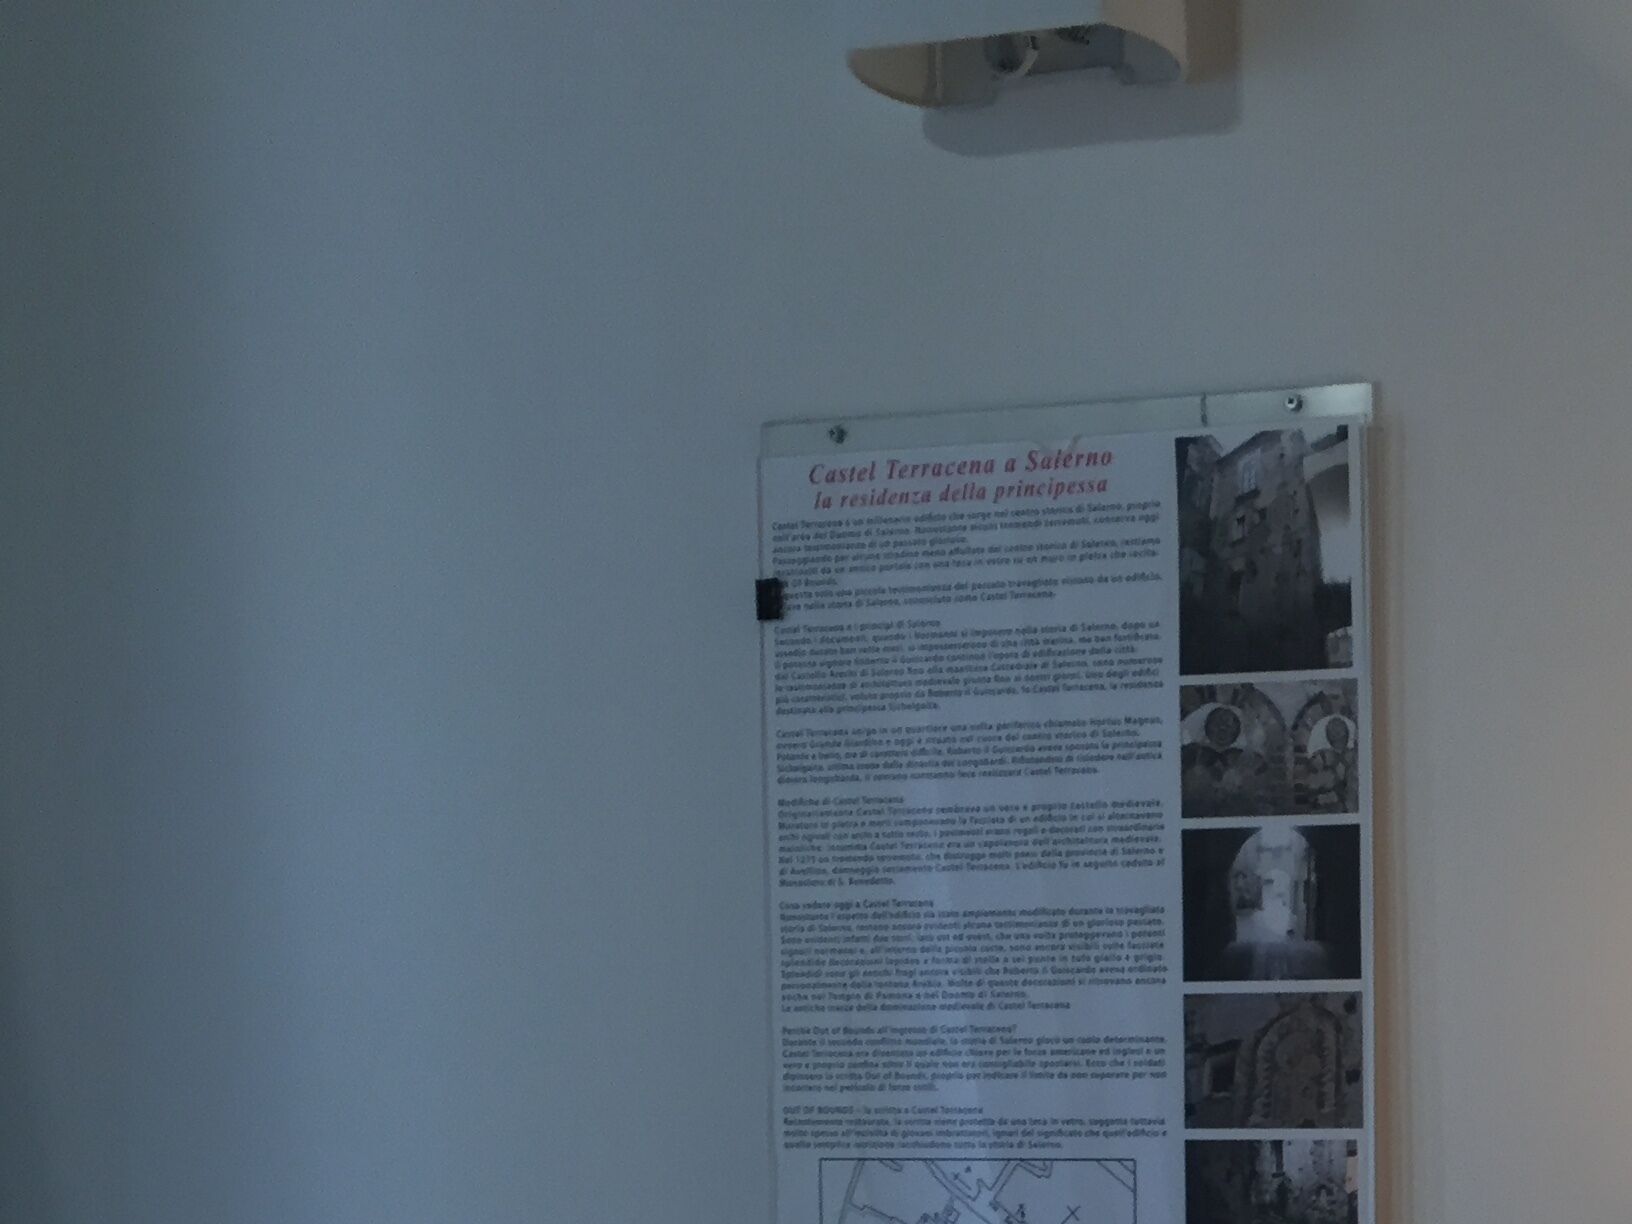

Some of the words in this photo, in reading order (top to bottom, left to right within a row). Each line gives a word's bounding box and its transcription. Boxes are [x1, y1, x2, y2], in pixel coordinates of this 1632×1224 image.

[809, 460, 876, 485] Castel
[886, 455, 995, 480] Terracena
[1003, 456, 1017, 473] a
[1025, 449, 1113, 472] Salerno
[814, 490, 832, 510] la
[840, 488, 931, 508] residenza
[938, 482, 987, 503] della
[992, 476, 1108, 503] principessa
